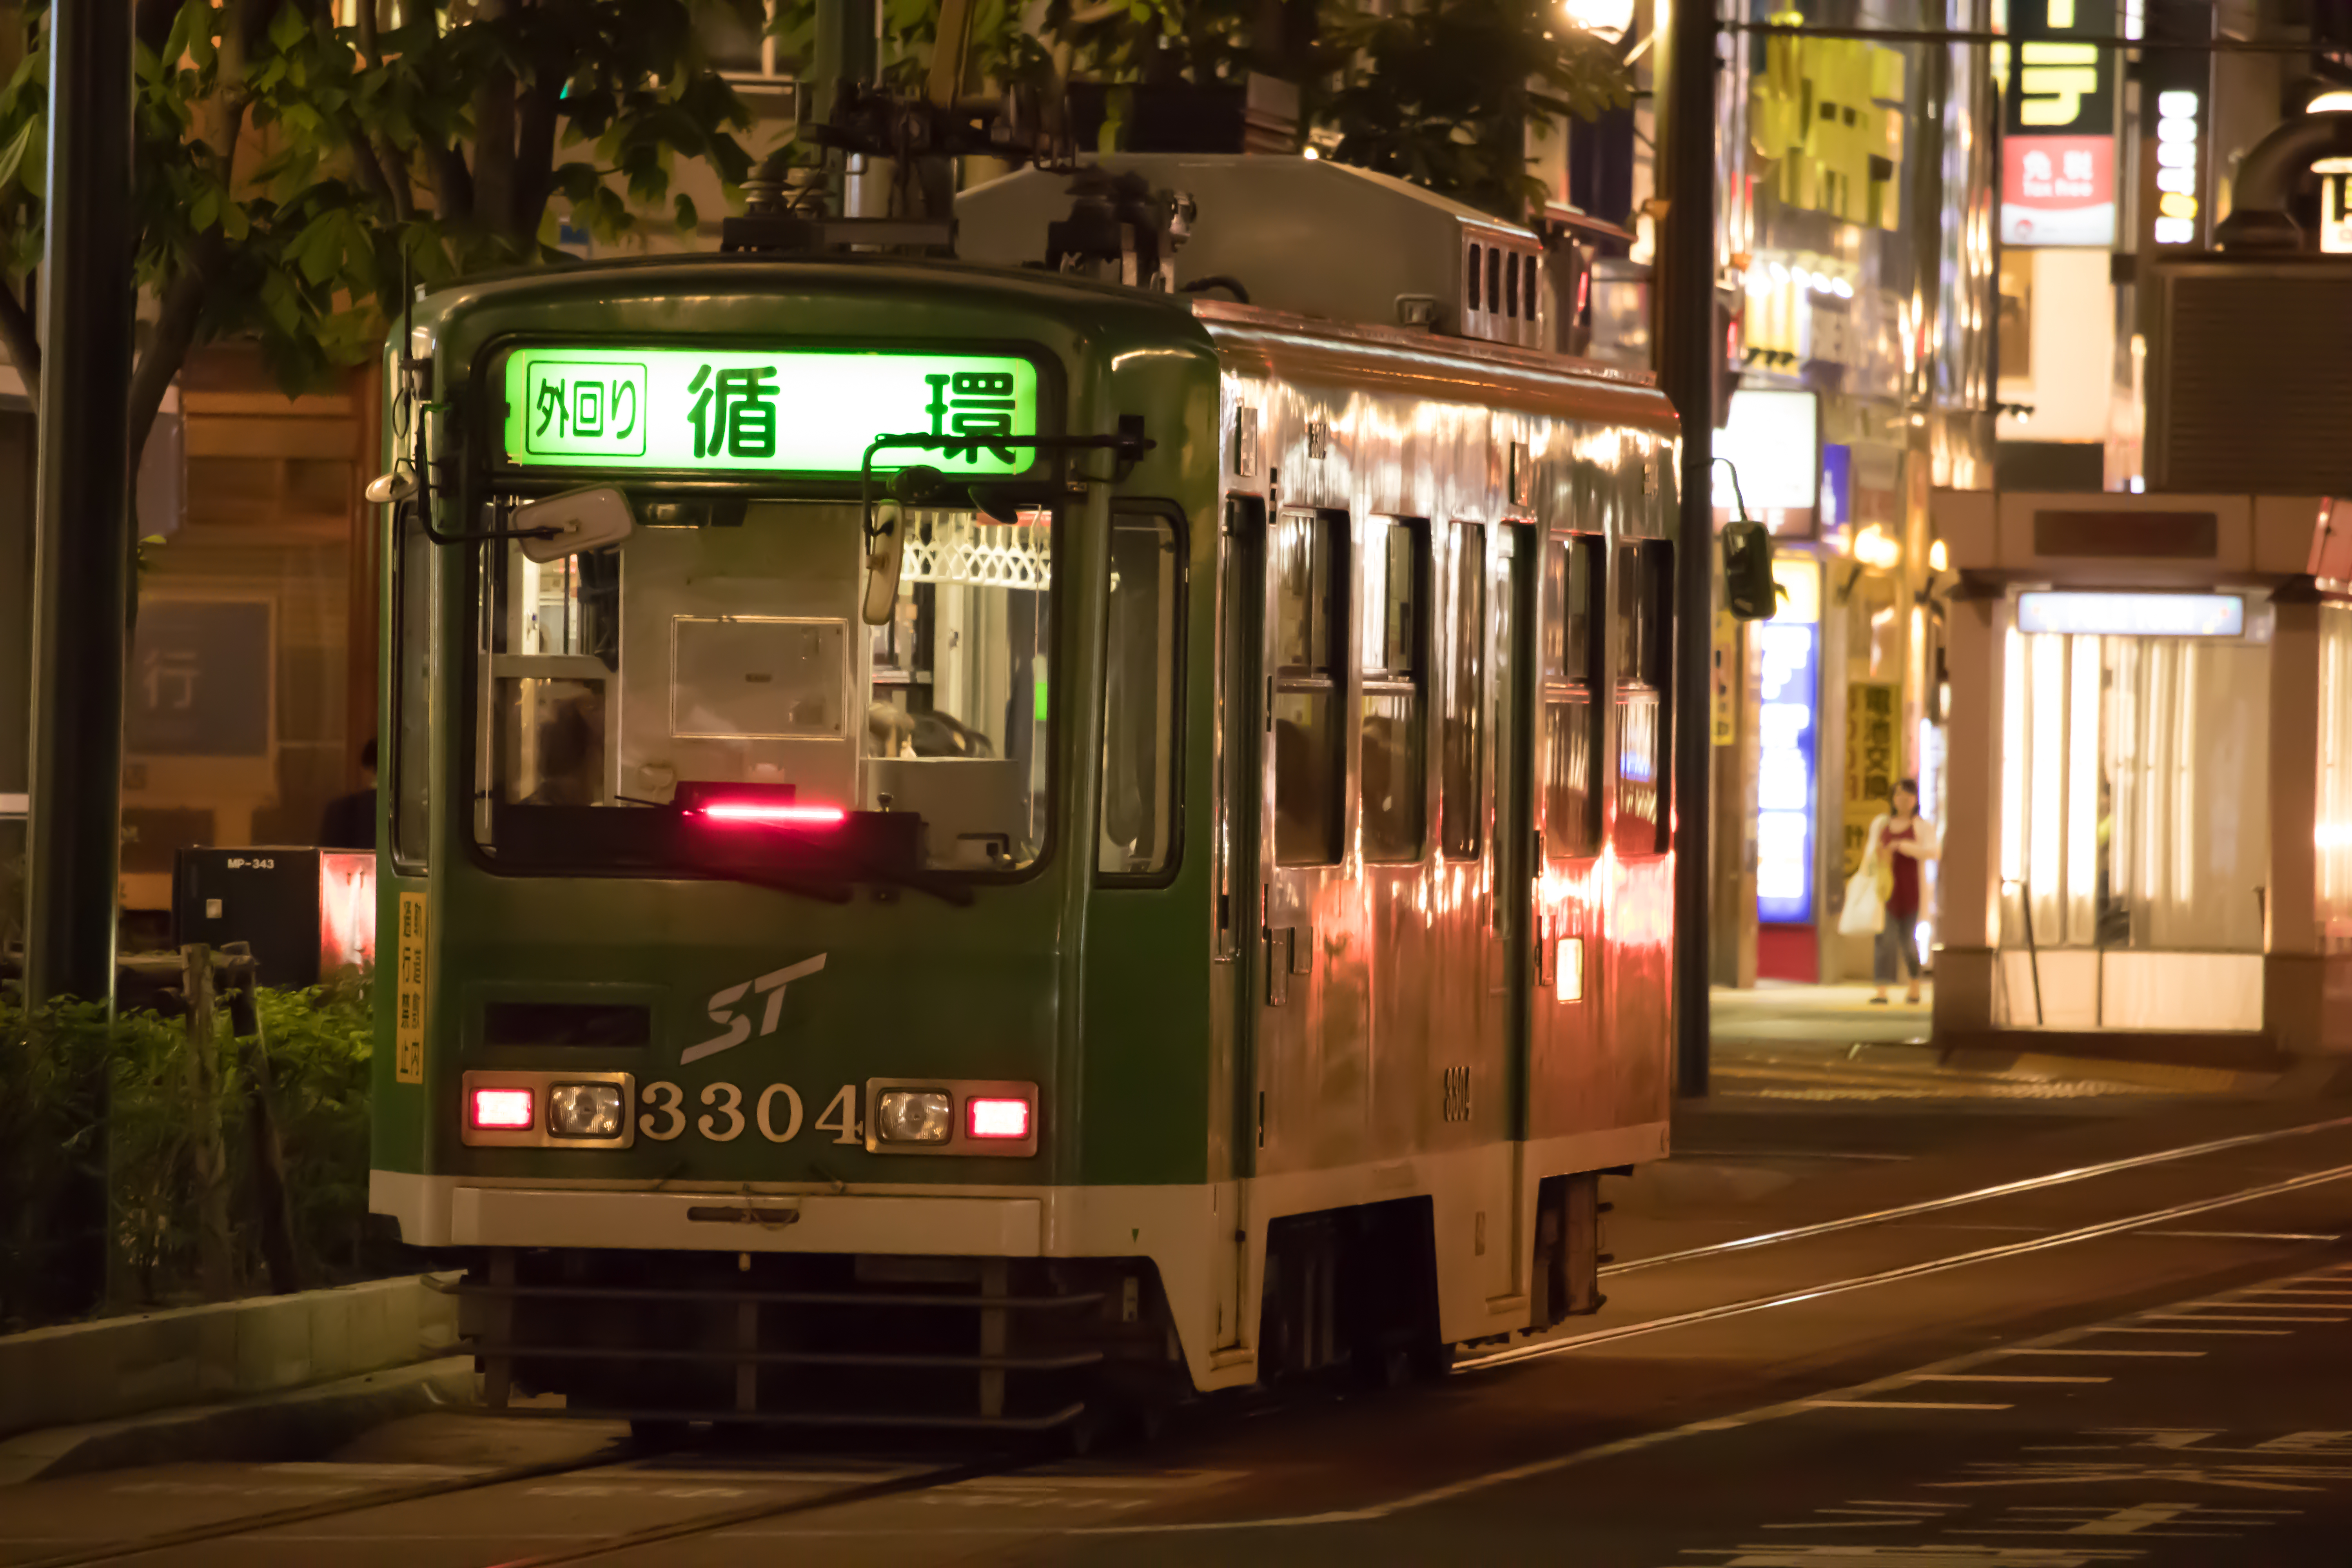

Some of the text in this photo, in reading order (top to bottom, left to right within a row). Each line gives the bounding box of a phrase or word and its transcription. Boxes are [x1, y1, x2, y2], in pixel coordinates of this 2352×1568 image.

[536, 378, 636, 438] 外回り
[227, 859, 274, 869] MP-343
[680, 953, 827, 1065] ST
[639, 1081, 864, 1145] 3304
